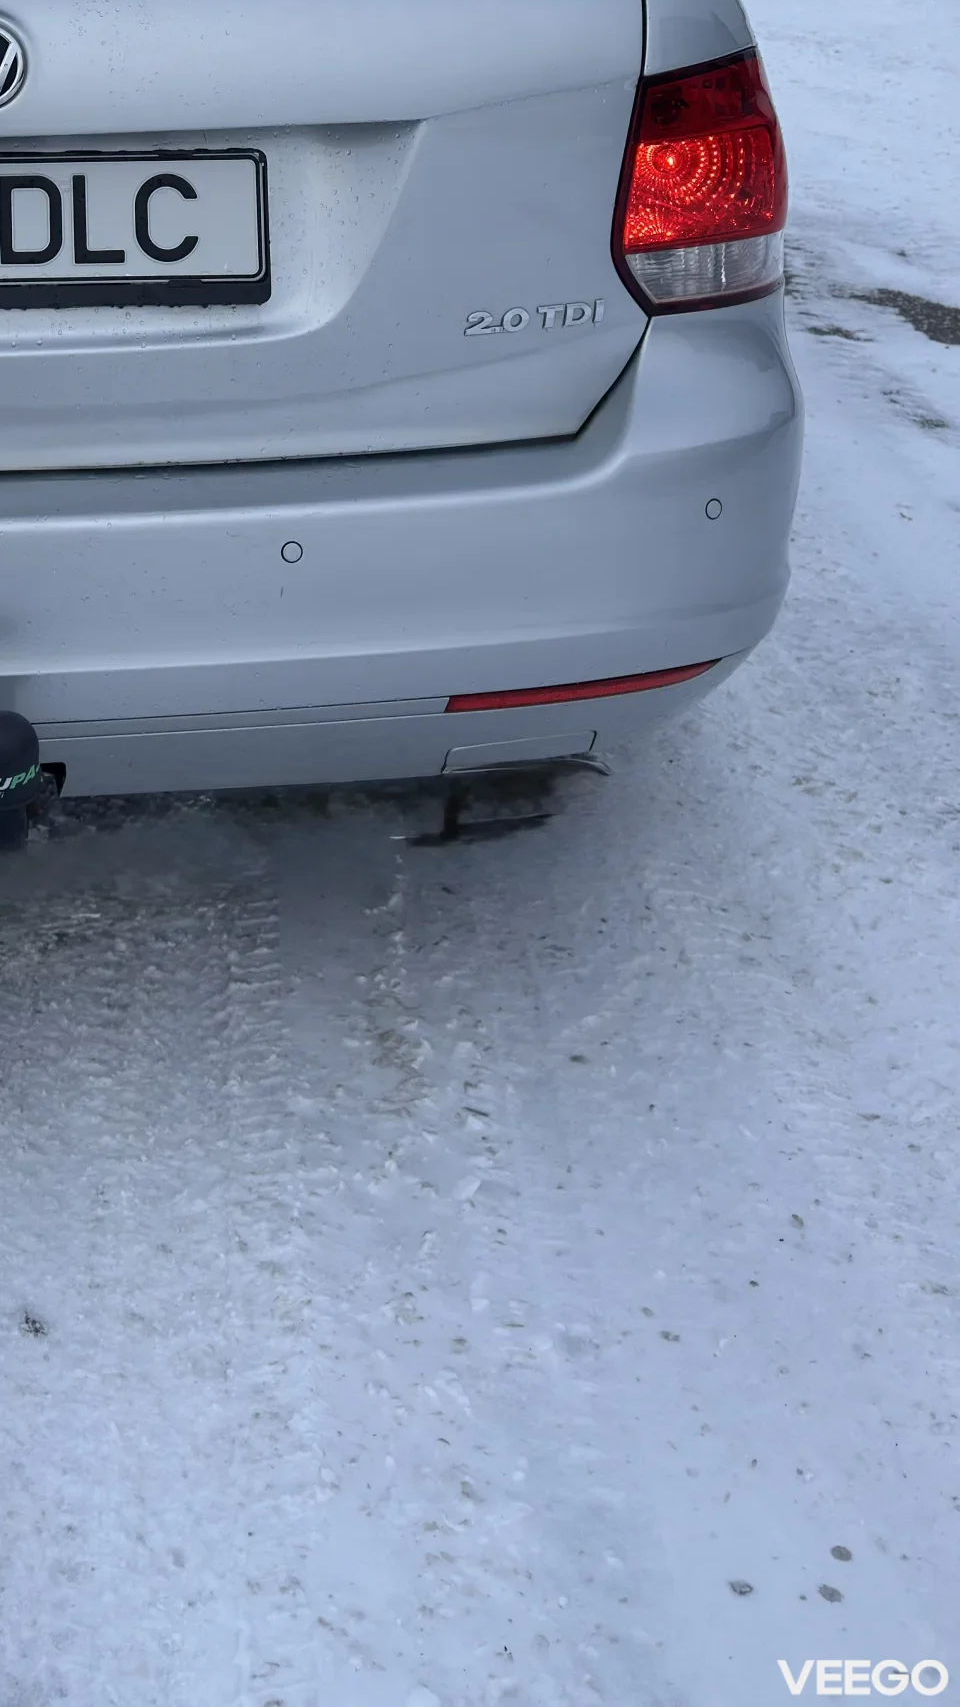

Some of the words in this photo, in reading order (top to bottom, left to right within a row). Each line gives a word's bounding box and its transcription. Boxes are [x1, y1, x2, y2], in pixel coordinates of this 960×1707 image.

[0, 173, 199, 265] DLC
[464, 306, 530, 337] 2.0
[536, 297, 605, 330] TDI
